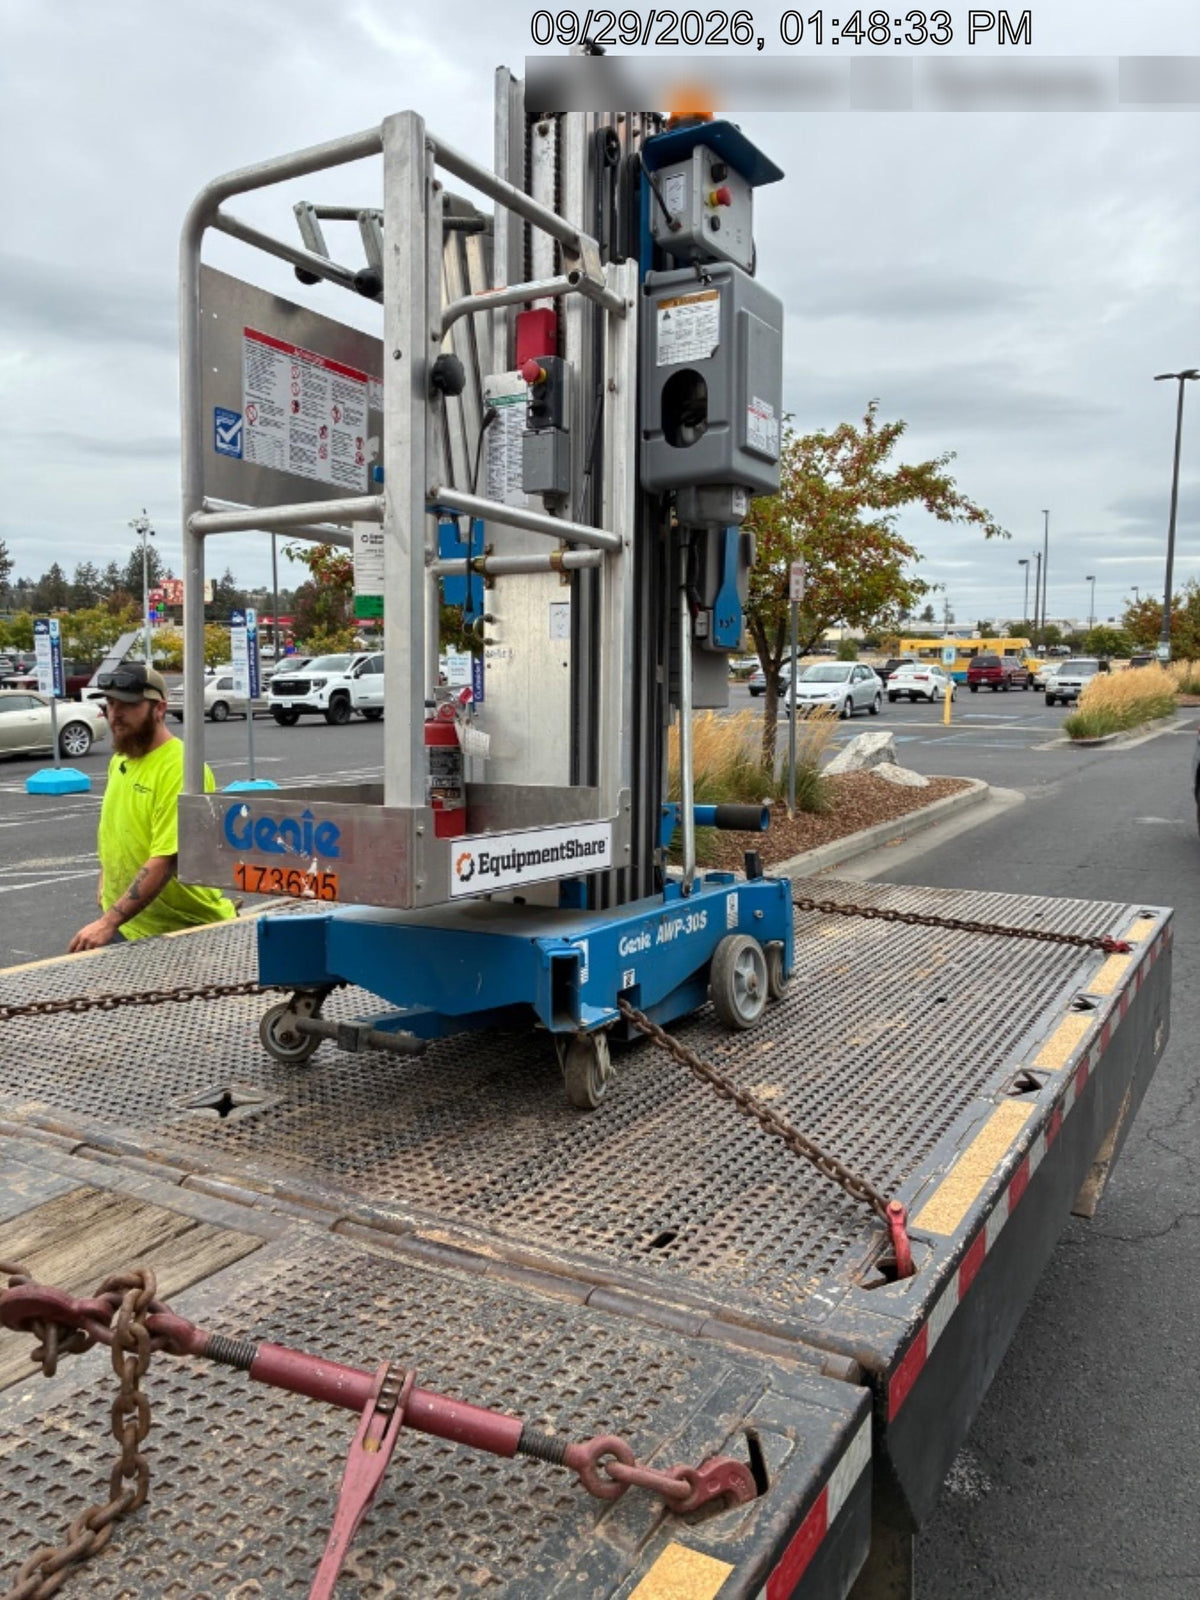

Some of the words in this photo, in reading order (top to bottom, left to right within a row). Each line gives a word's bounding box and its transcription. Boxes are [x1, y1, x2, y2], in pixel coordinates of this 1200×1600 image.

[224, 803, 341, 858] Genie
[478, 838, 606, 877] EquipmentShare
[618, 931, 652, 957] Genie
[656, 910, 708, 945] AWP-30S
